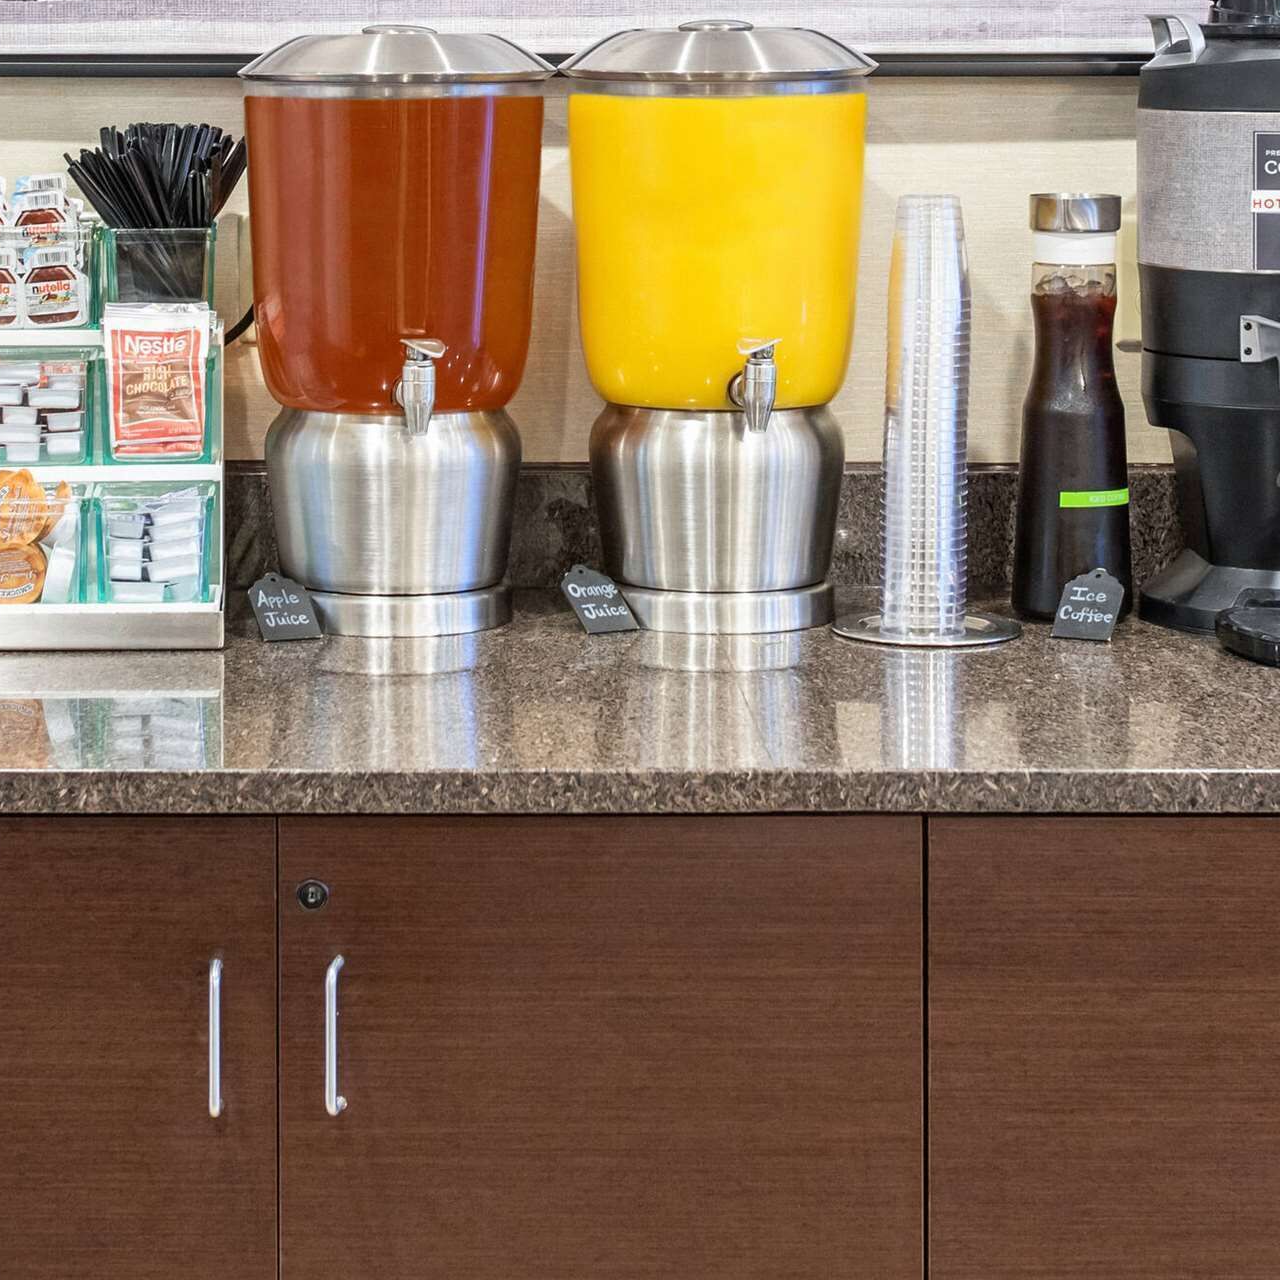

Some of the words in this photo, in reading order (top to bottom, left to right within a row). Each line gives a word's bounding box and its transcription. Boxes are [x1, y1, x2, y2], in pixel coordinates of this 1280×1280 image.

[32, 282, 71, 295] nutella
[126, 375, 188, 395] CHOCOLATE
[257, 588, 300, 609] Apple
[567, 583, 618, 599] Orange
[1070, 586, 1107, 602] Ice
[581, 603, 628, 619] Juice
[1059, 605, 1113, 623] Coffee
[263, 611, 310, 628] Juice
